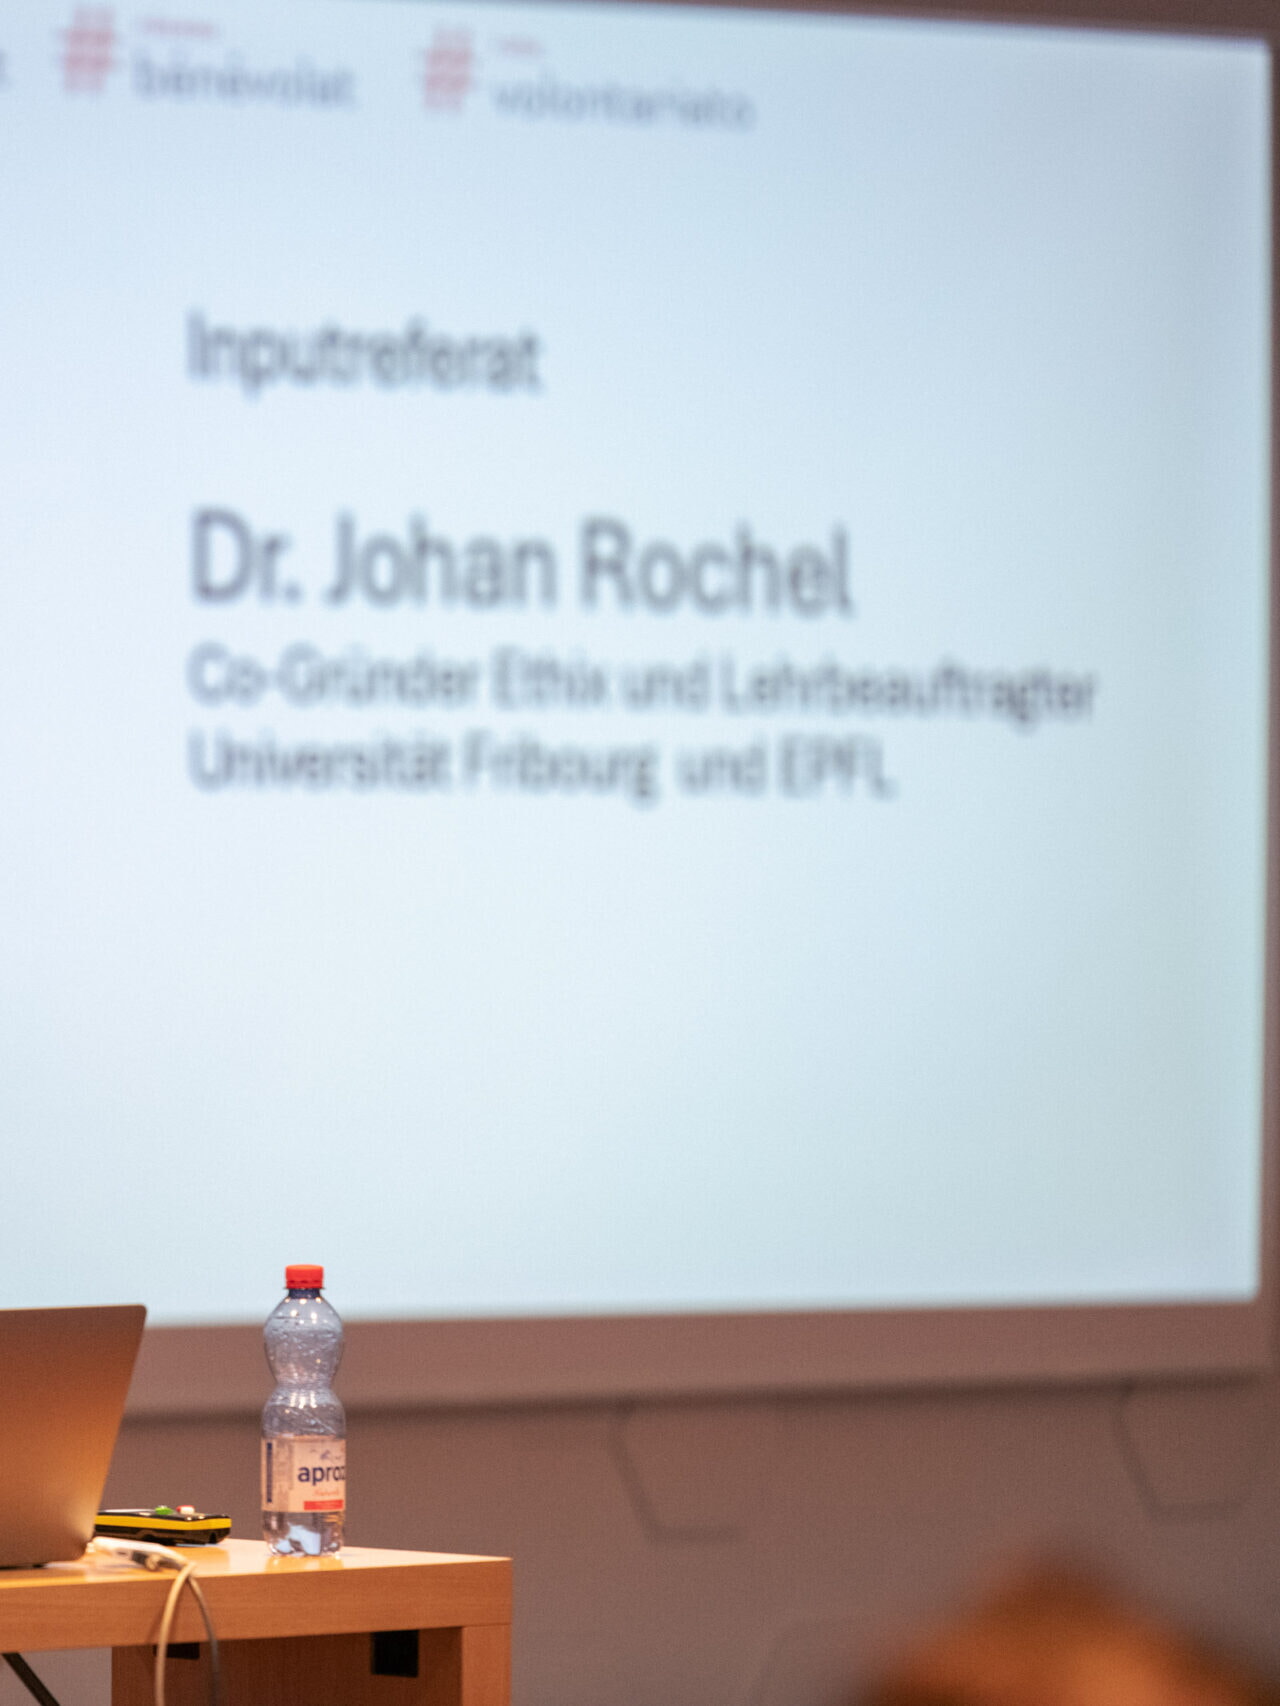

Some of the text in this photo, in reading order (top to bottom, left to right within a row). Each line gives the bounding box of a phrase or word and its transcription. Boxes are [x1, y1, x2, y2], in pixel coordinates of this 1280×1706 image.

[186, 308, 546, 398] Inputreferat
[192, 506, 854, 618] Dr. Johan Rochel
[186, 642, 1096, 732] Co-Gründer Ethix und Lehrbeauftragter
[186, 730, 896, 806] Universität Fribourg und EPFL
